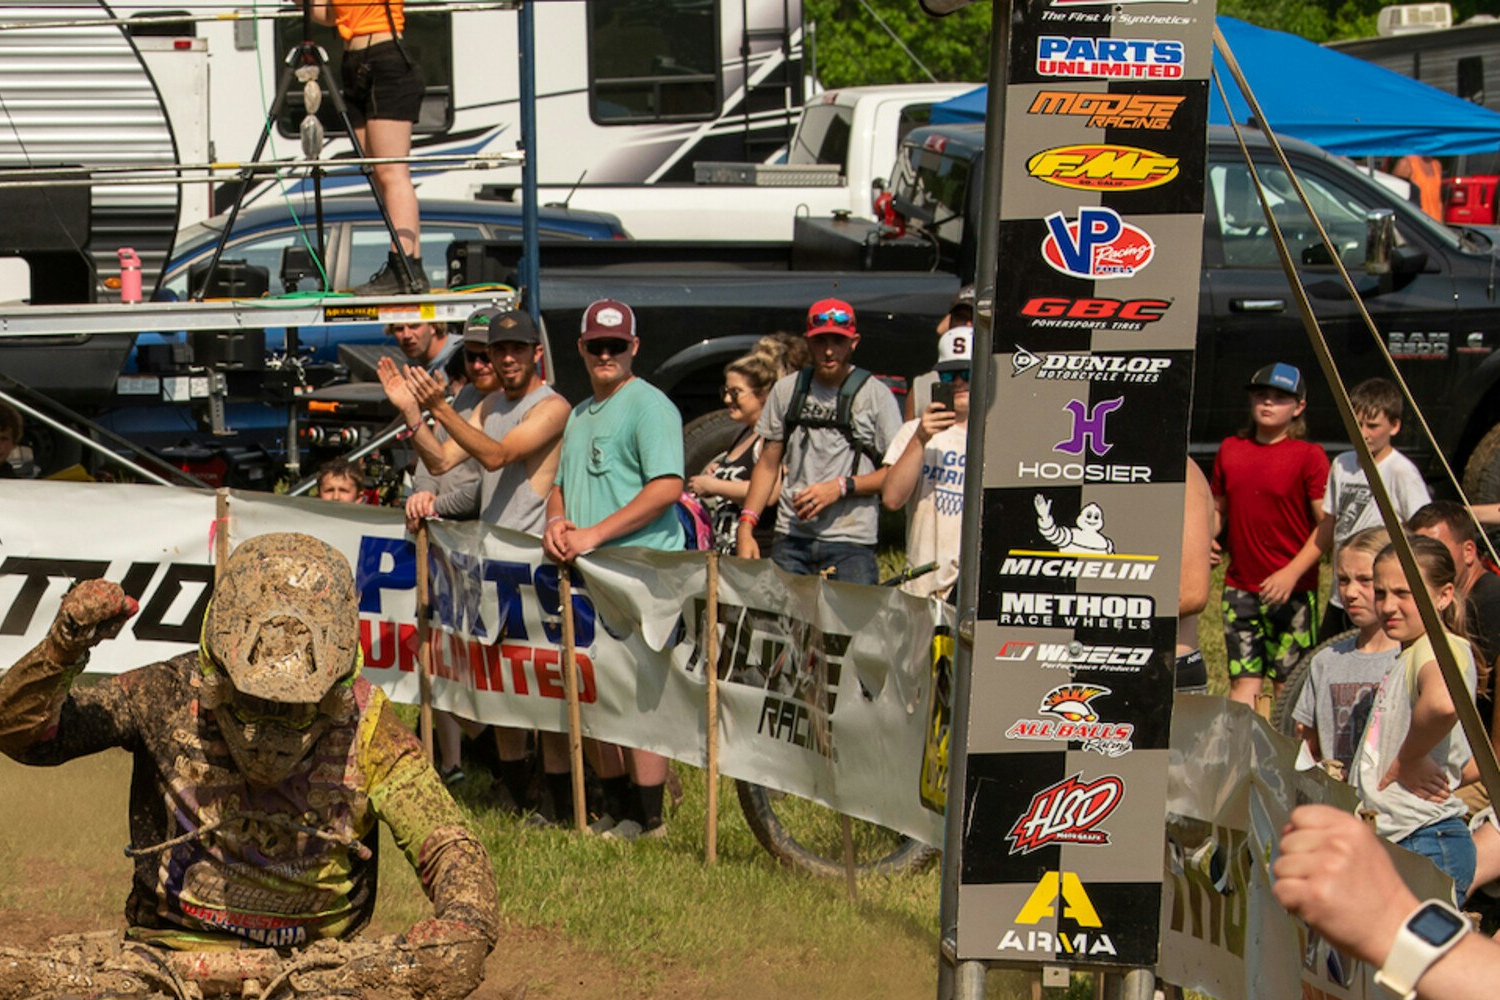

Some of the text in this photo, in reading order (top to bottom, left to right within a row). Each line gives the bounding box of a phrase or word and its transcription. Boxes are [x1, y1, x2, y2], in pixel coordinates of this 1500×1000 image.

[1041, 10, 1191, 26] The First in Synthetics
[1038, 37, 1183, 64] PARTS
[1038, 61, 1182, 78] UNLIMITED
[1028, 90, 1187, 118] MOOSE
[1086, 114, 1170, 131] RACING
[1029, 151, 1180, 181] FMF
[1048, 210, 1121, 275] VP
[1095, 244, 1156, 266] Racing
[1095, 265, 1134, 274] FUELS
[1020, 296, 1172, 321] GBC
[1031, 318, 1142, 331] POWERSPORTS TIRES
[952, 337, 966, 355] S
[1388, 332, 1450, 343] RAM
[1042, 354, 1172, 374] DUNLOP
[1036, 369, 1160, 383] MOTORCYCLE TIRES
[1017, 461, 1153, 483] HOOSIER
[999, 557, 1156, 581] MICHELIN
[1001, 592, 1153, 619] METHOD
[1000, 613, 1152, 630] RACE WHEELS
[1040, 662, 1141, 673] Perforance Products
[1008, 721, 1132, 741] ALL BALLS
[1085, 738, 1132, 757] Racing
[997, 929, 1118, 956] ARMA
